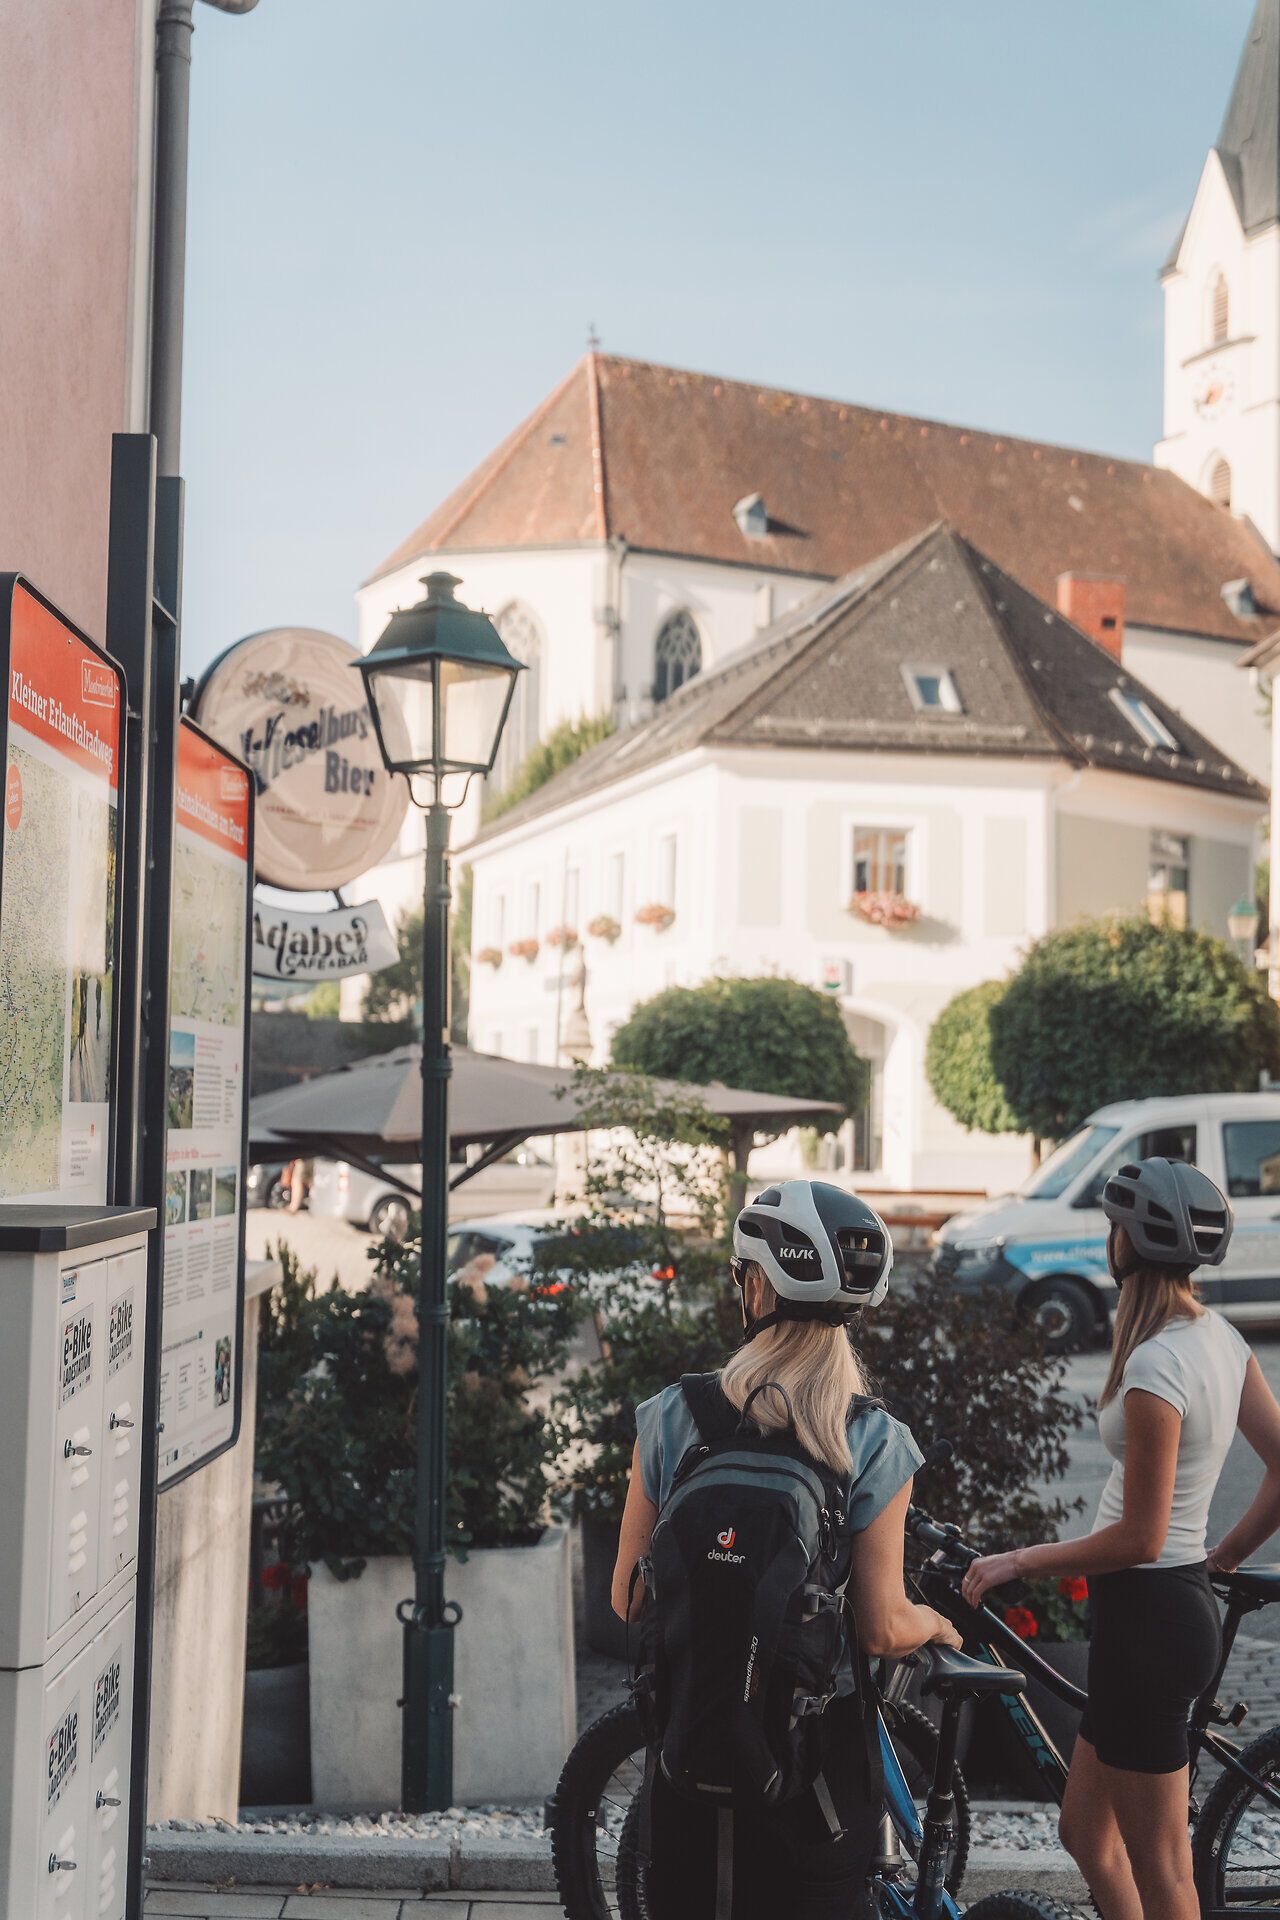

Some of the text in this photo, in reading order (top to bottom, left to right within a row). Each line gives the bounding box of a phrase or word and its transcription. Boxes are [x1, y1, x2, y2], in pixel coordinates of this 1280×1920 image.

[11, 669, 113, 774] Kleiner Erlauftalradweg
[325, 751, 375, 797] Bier
[780, 1247, 814, 1260] KASK
[63, 1317, 92, 1366] e-Bike
[109, 1299, 133, 1344] e-Bike
[707, 1548, 746, 1564] deuter
[95, 1662, 120, 1719] e-Bike
[743, 1653, 756, 1703] speedlite
[751, 1635, 759, 1654] 20
[49, 1712, 78, 1779] e-Bike
